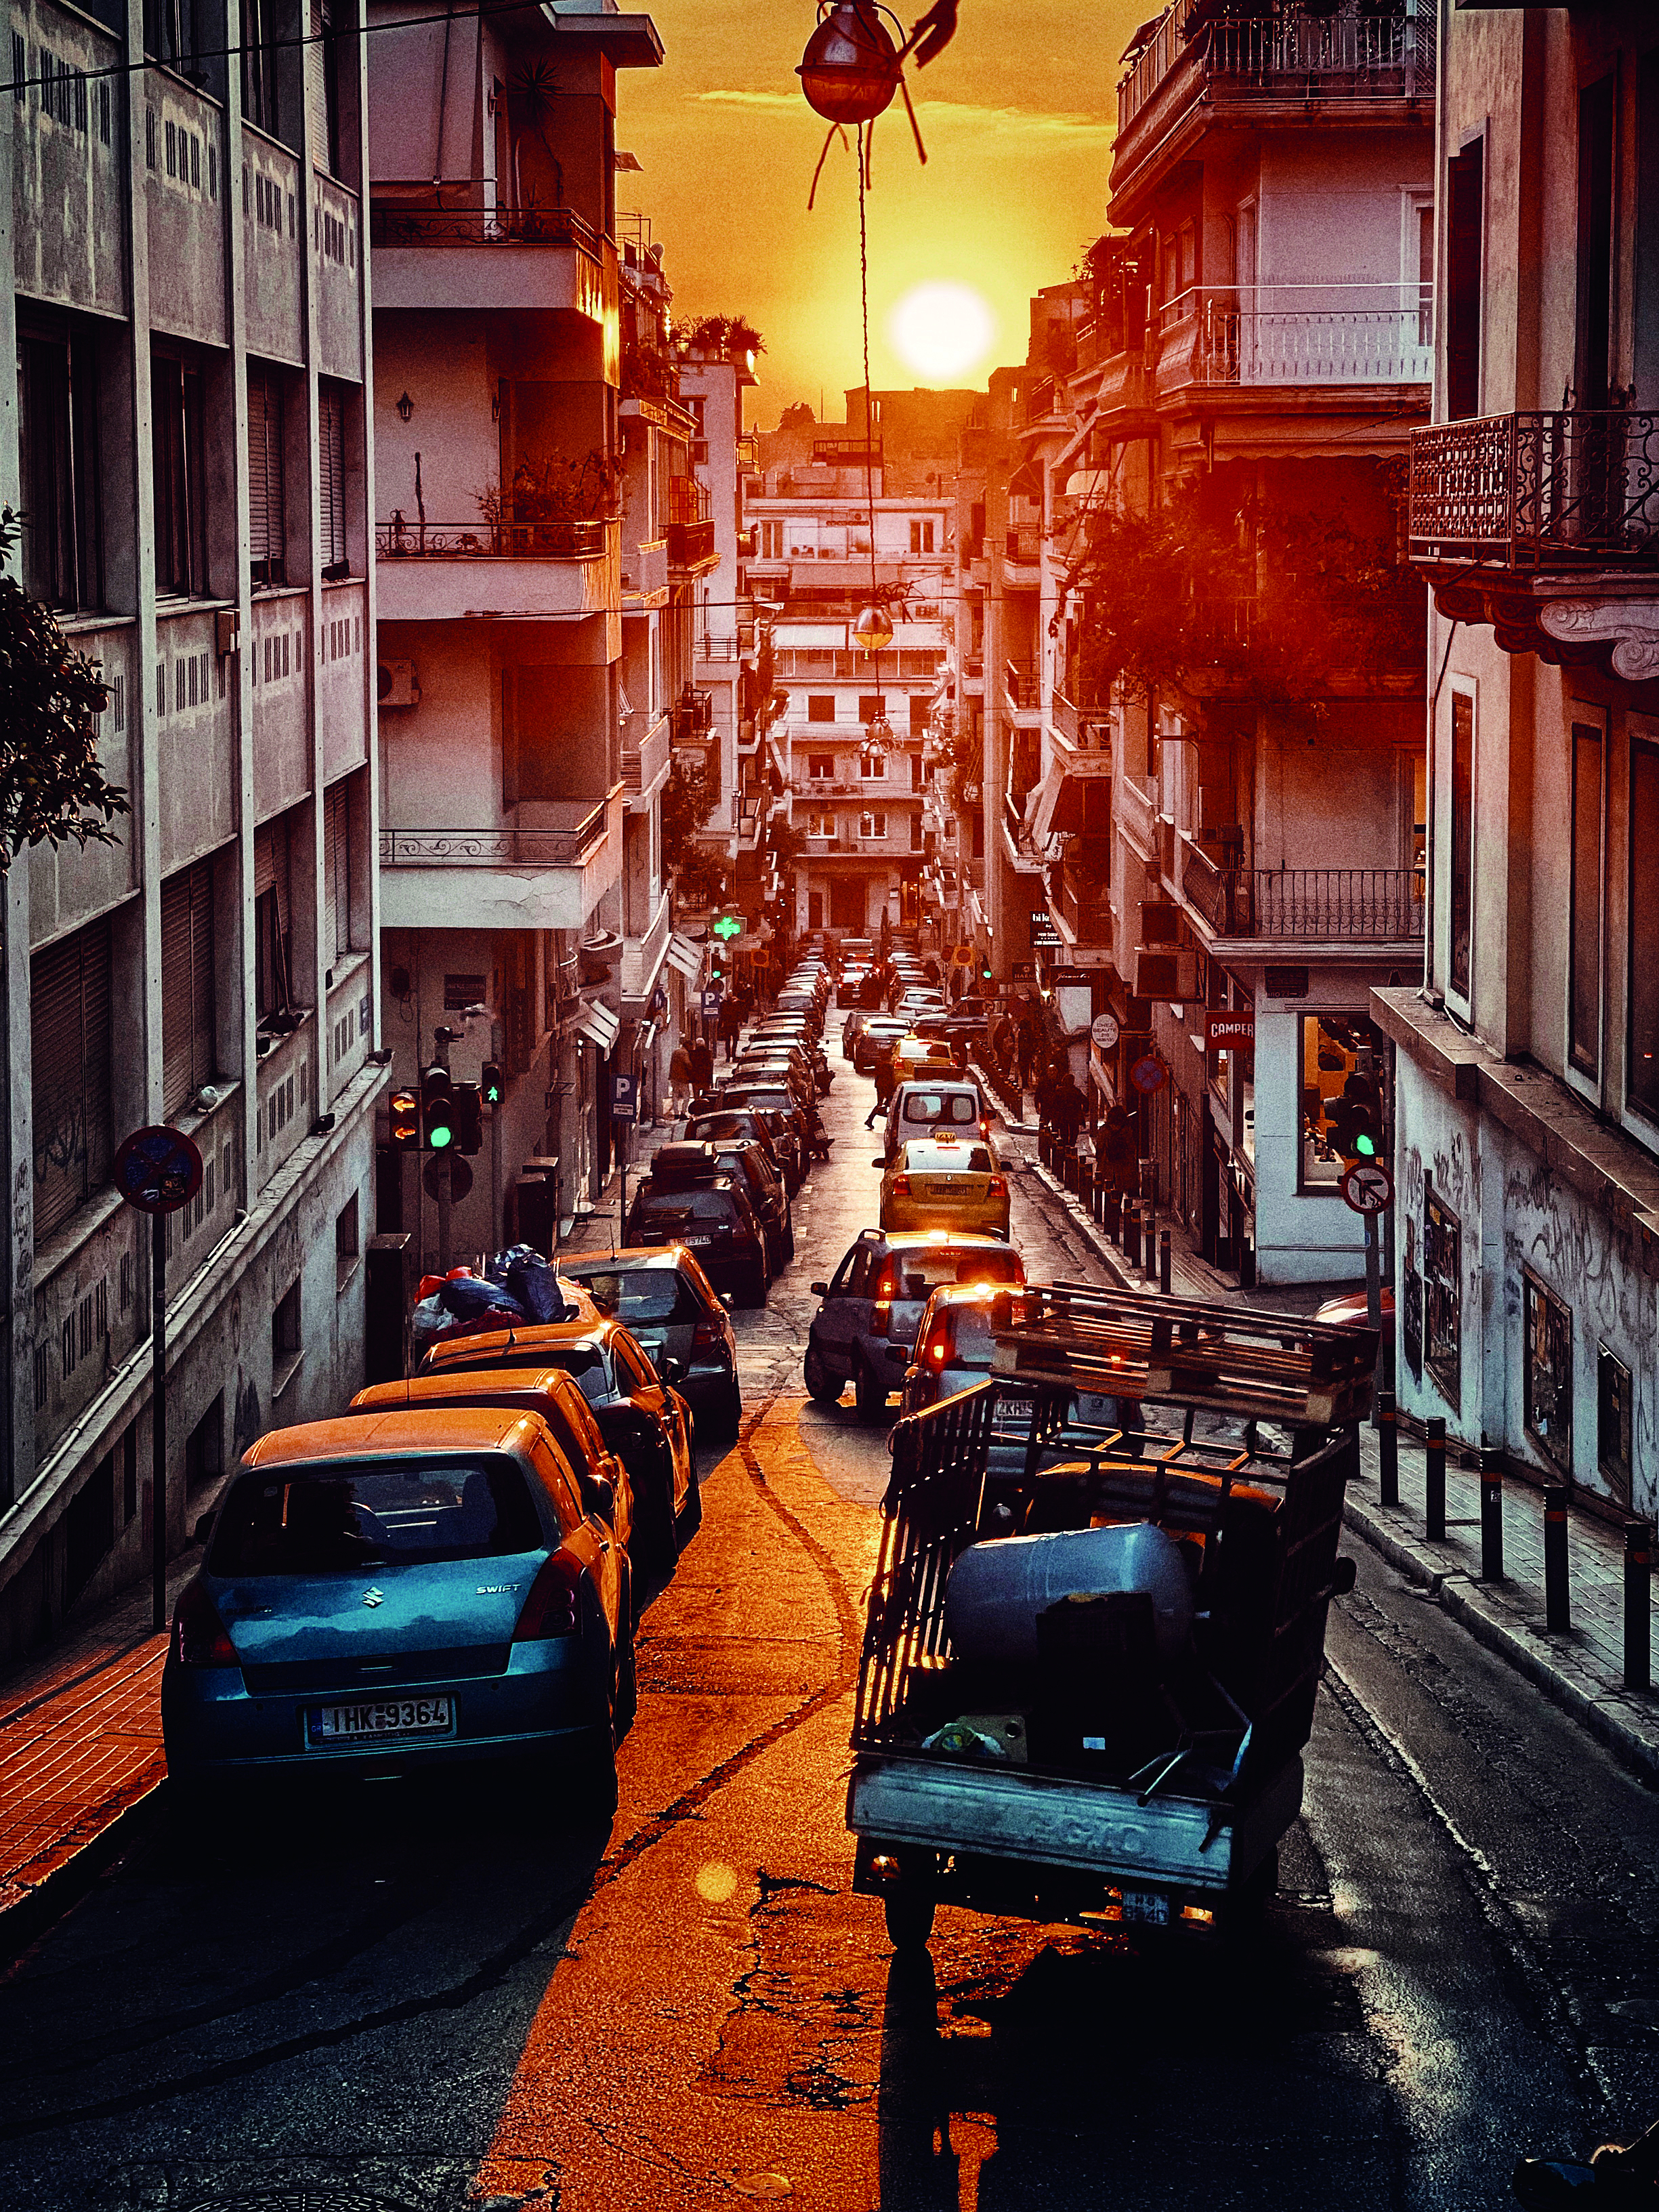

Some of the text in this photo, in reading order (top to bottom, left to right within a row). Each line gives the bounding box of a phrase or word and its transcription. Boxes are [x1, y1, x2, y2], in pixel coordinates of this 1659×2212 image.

[705, 992, 715, 1005] P
[1211, 1023, 1254, 1039] CAMPER
[616, 1077, 631, 1099] P
[476, 1583, 522, 1594] SWIFT
